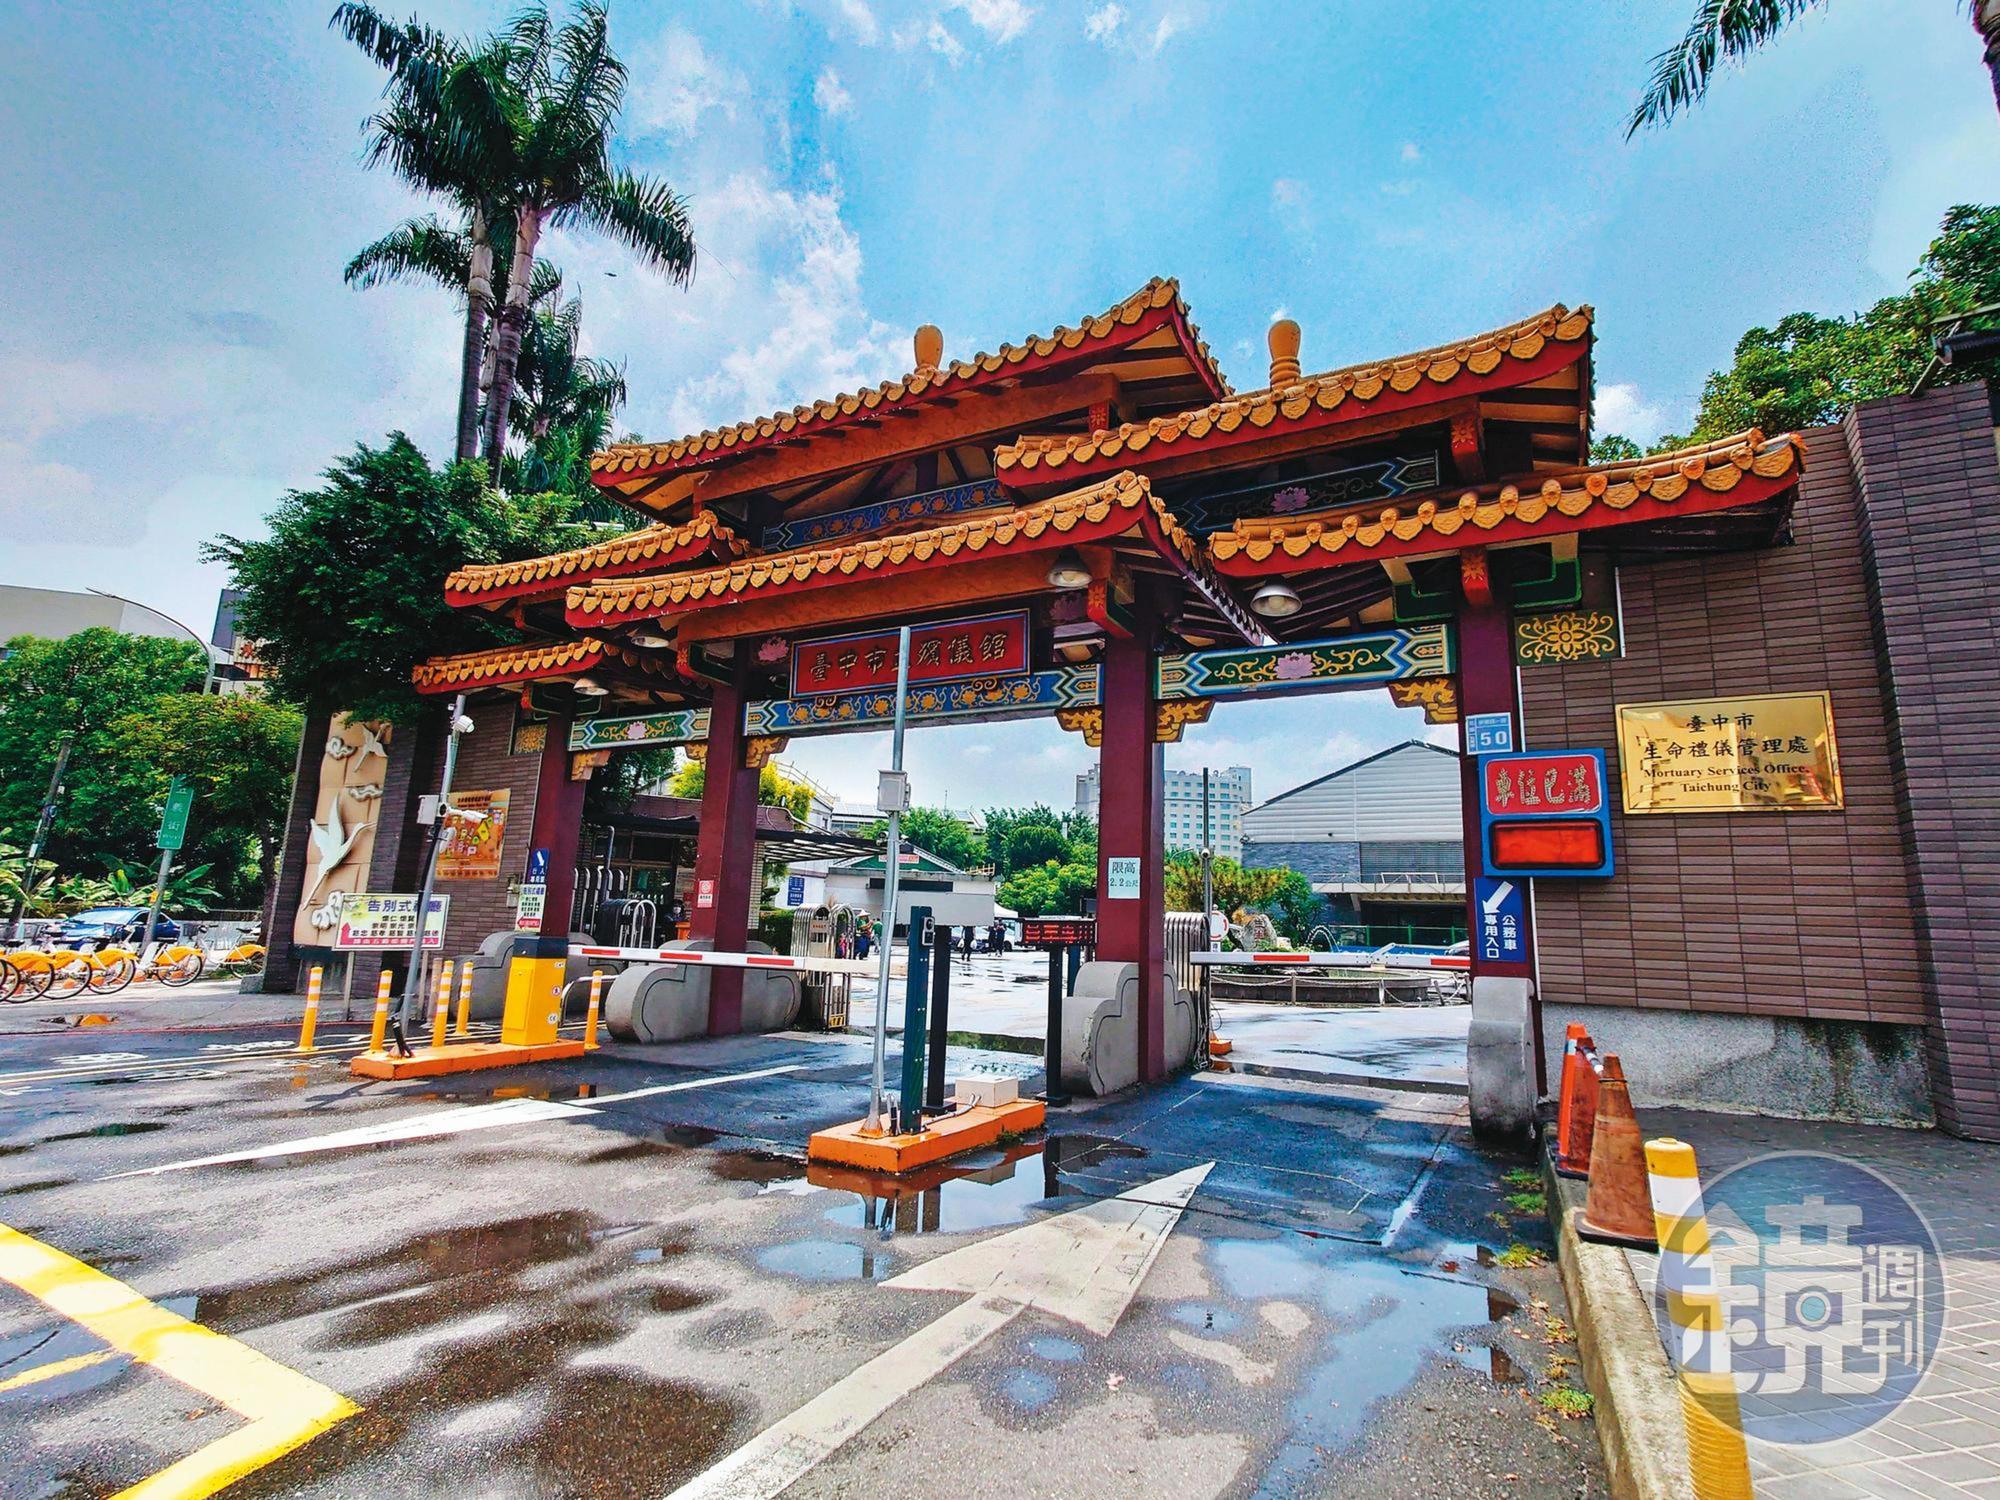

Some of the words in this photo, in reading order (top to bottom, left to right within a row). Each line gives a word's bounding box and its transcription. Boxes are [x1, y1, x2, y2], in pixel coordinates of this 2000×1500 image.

[1686, 712, 1755, 733] 臺中市
[1480, 731, 1508, 746] 50
[1643, 735, 1812, 760] 生命禮儀管理處
[1644, 768, 1703, 778] Mortuary
[1707, 766, 1760, 776] Services
[1496, 764, 1591, 807] 車位已滿
[1680, 782, 1741, 793] Taichung
[1743, 781, 1772, 792] City
[1112, 861, 1136, 874] 限高
[368, 900, 443, 912] 告別式廳
[1484, 914, 1500, 958] 專用入口
[1502, 914, 1517, 951] 公務車
